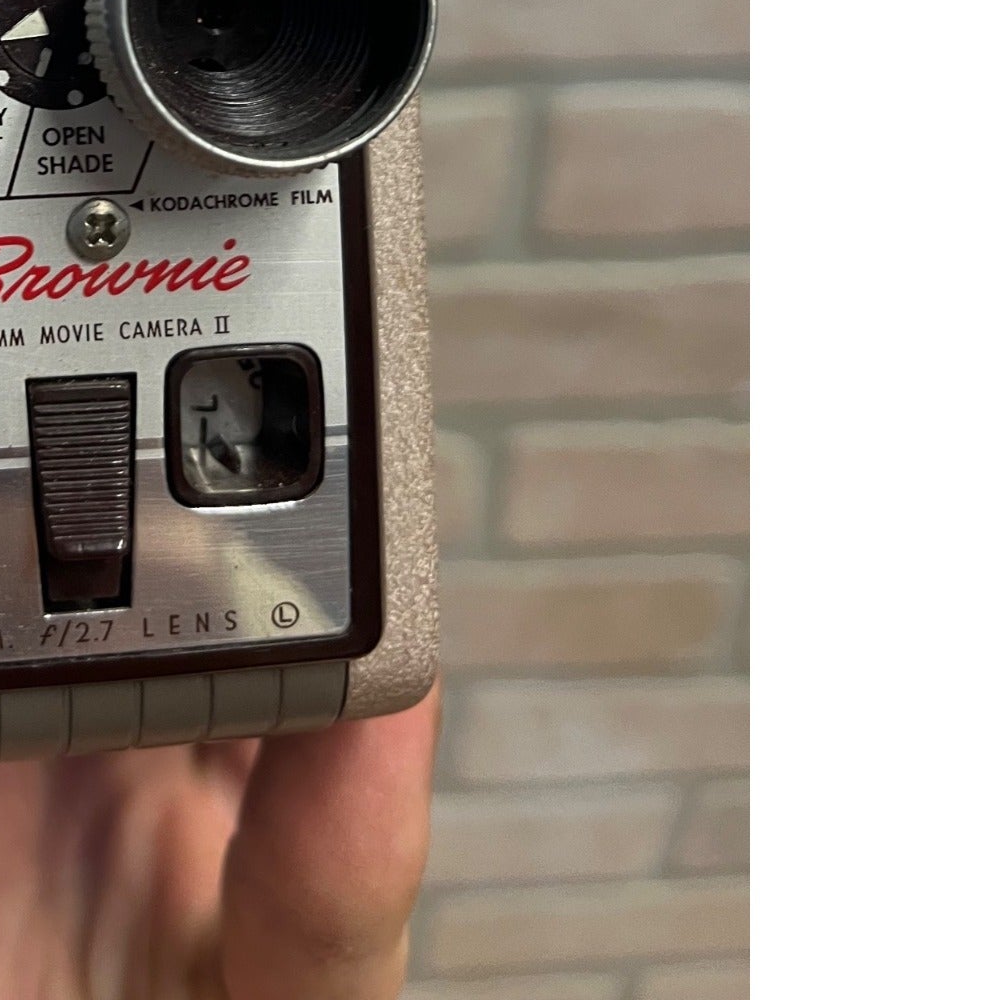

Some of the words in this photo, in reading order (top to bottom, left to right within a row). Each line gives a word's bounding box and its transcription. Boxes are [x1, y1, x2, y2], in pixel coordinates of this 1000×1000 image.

[42, 125, 105, 146] OPEN
[38, 153, 114, 175] SHADE
[150, 192, 280, 213] KODACHROME
[291, 189, 333, 206] FILM
[40, 322, 104, 345] MOVIE
[119, 317, 203, 340] CAMERA
[215, 315, 231, 335] II
[39, 620, 114, 647] f/2.7
[143, 609, 238, 638] LENS
